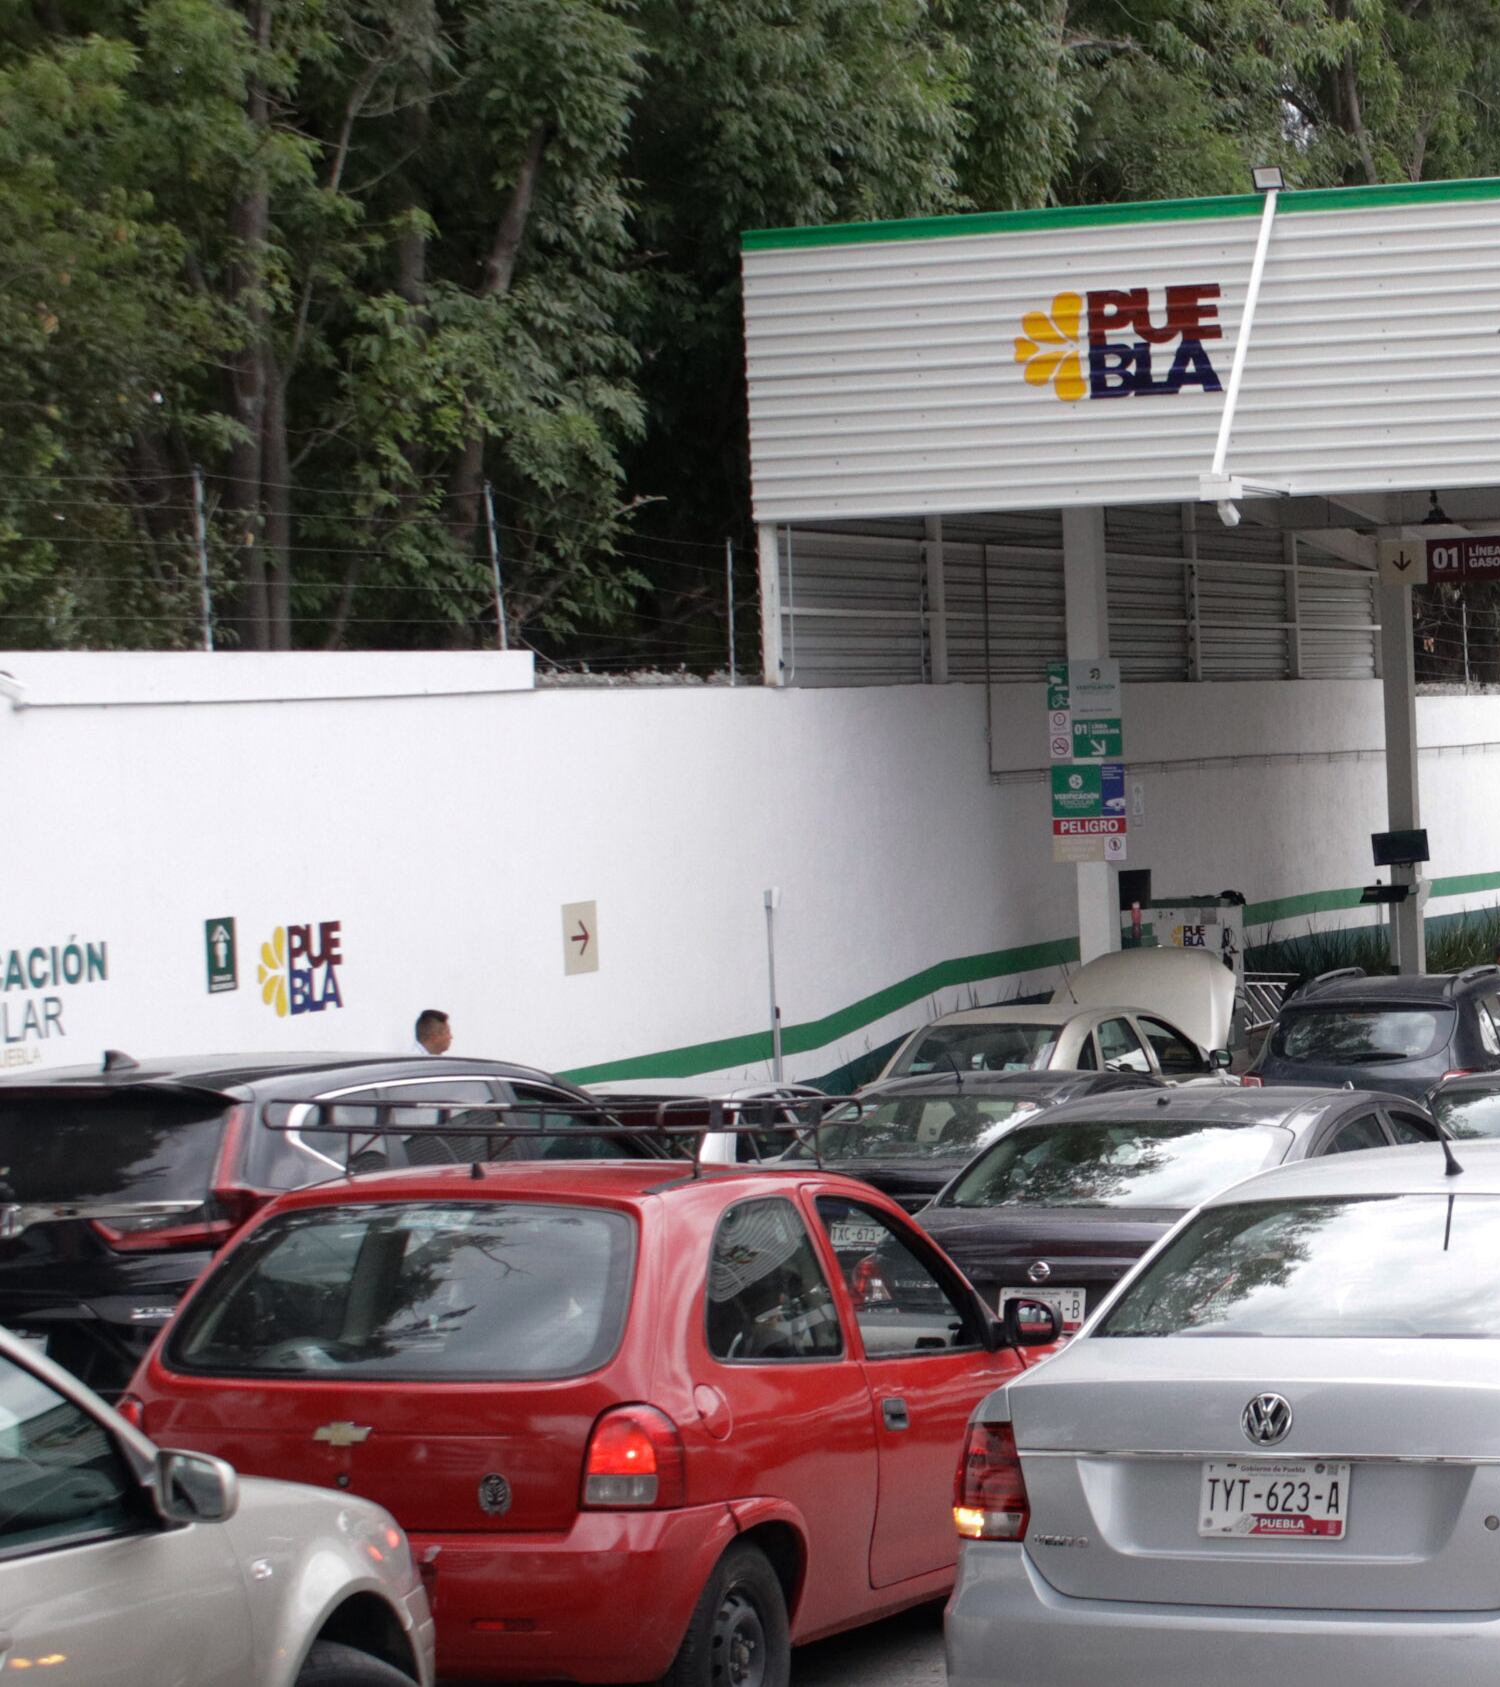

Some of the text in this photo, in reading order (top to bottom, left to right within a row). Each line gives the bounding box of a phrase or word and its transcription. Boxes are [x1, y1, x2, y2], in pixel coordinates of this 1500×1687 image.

[1086, 283, 1222, 346] PUE
[1088, 340, 1223, 399] BLA
[1433, 547, 1459, 569] 01
[1074, 724, 1088, 735] 01
[1060, 820, 1119, 833] PELIGRO
[0, 933, 109, 992] ACIÓN
[287, 920, 342, 967] PUE
[289, 962, 343, 1015] BLA
[1208, 1479, 1340, 1514] TYT-623-A
[1260, 1518, 1304, 1529] PUEBLA
